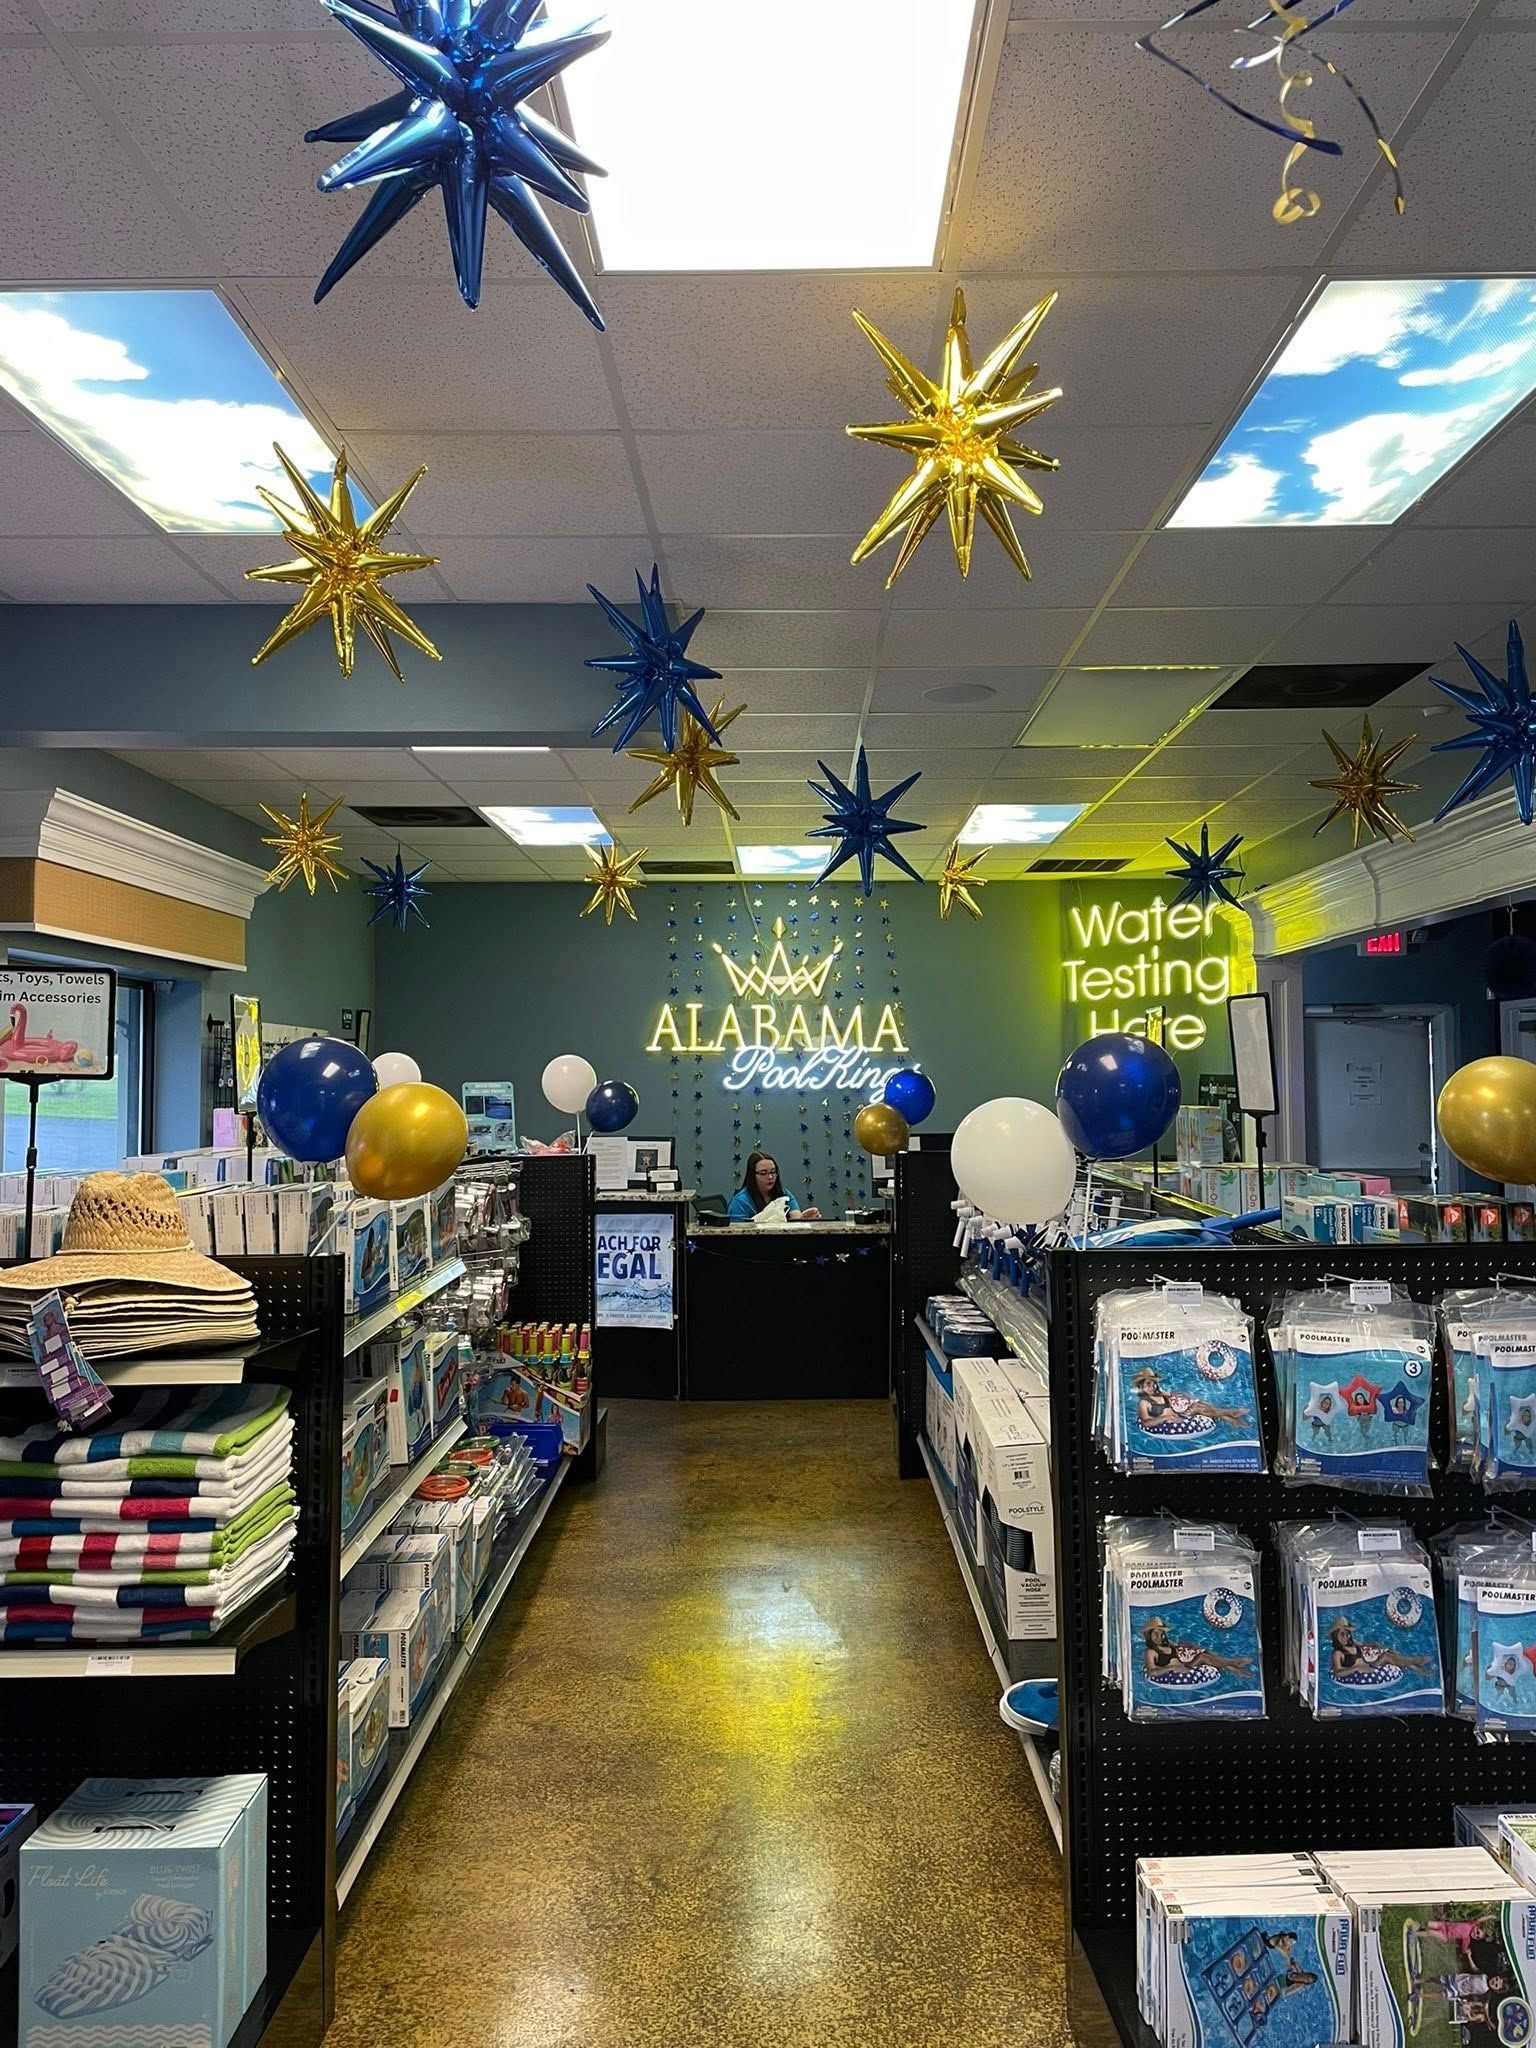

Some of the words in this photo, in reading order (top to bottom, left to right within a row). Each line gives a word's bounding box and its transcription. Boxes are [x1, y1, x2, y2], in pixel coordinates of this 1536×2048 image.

[1072, 895, 1217, 947] Water
[17, 972, 53, 986] Toys,
[57, 973, 105, 985] Towels
[1062, 945, 1230, 1006] Testing
[19, 991, 102, 1004] Accessories
[645, 1002, 910, 1053] ALABAMA
[1090, 1008, 1207, 1051] He
[722, 1045, 829, 1090] Pool
[597, 1235, 628, 1251] ACH
[633, 1235, 661, 1252] FOR
[598, 1252, 662, 1280] EGAL
[1299, 1333, 1351, 1343] POOLMASTER
[1494, 1345, 1536, 1353] POOLMAST
[1009, 1505, 1045, 1514] POOLSTYLE
[1130, 1579, 1185, 1589] POOLMASTER
[1317, 1578, 1369, 1590] POOLMASTER
[1481, 1590, 1536, 1601] POOLMASTER
[27, 1864, 70, 1888] Float
[74, 1864, 109, 1888] Life
[150, 1863, 172, 1874] BLUE
[1339, 1918, 1350, 1951] AQUA
[1336, 1953, 1346, 1976] FUN
